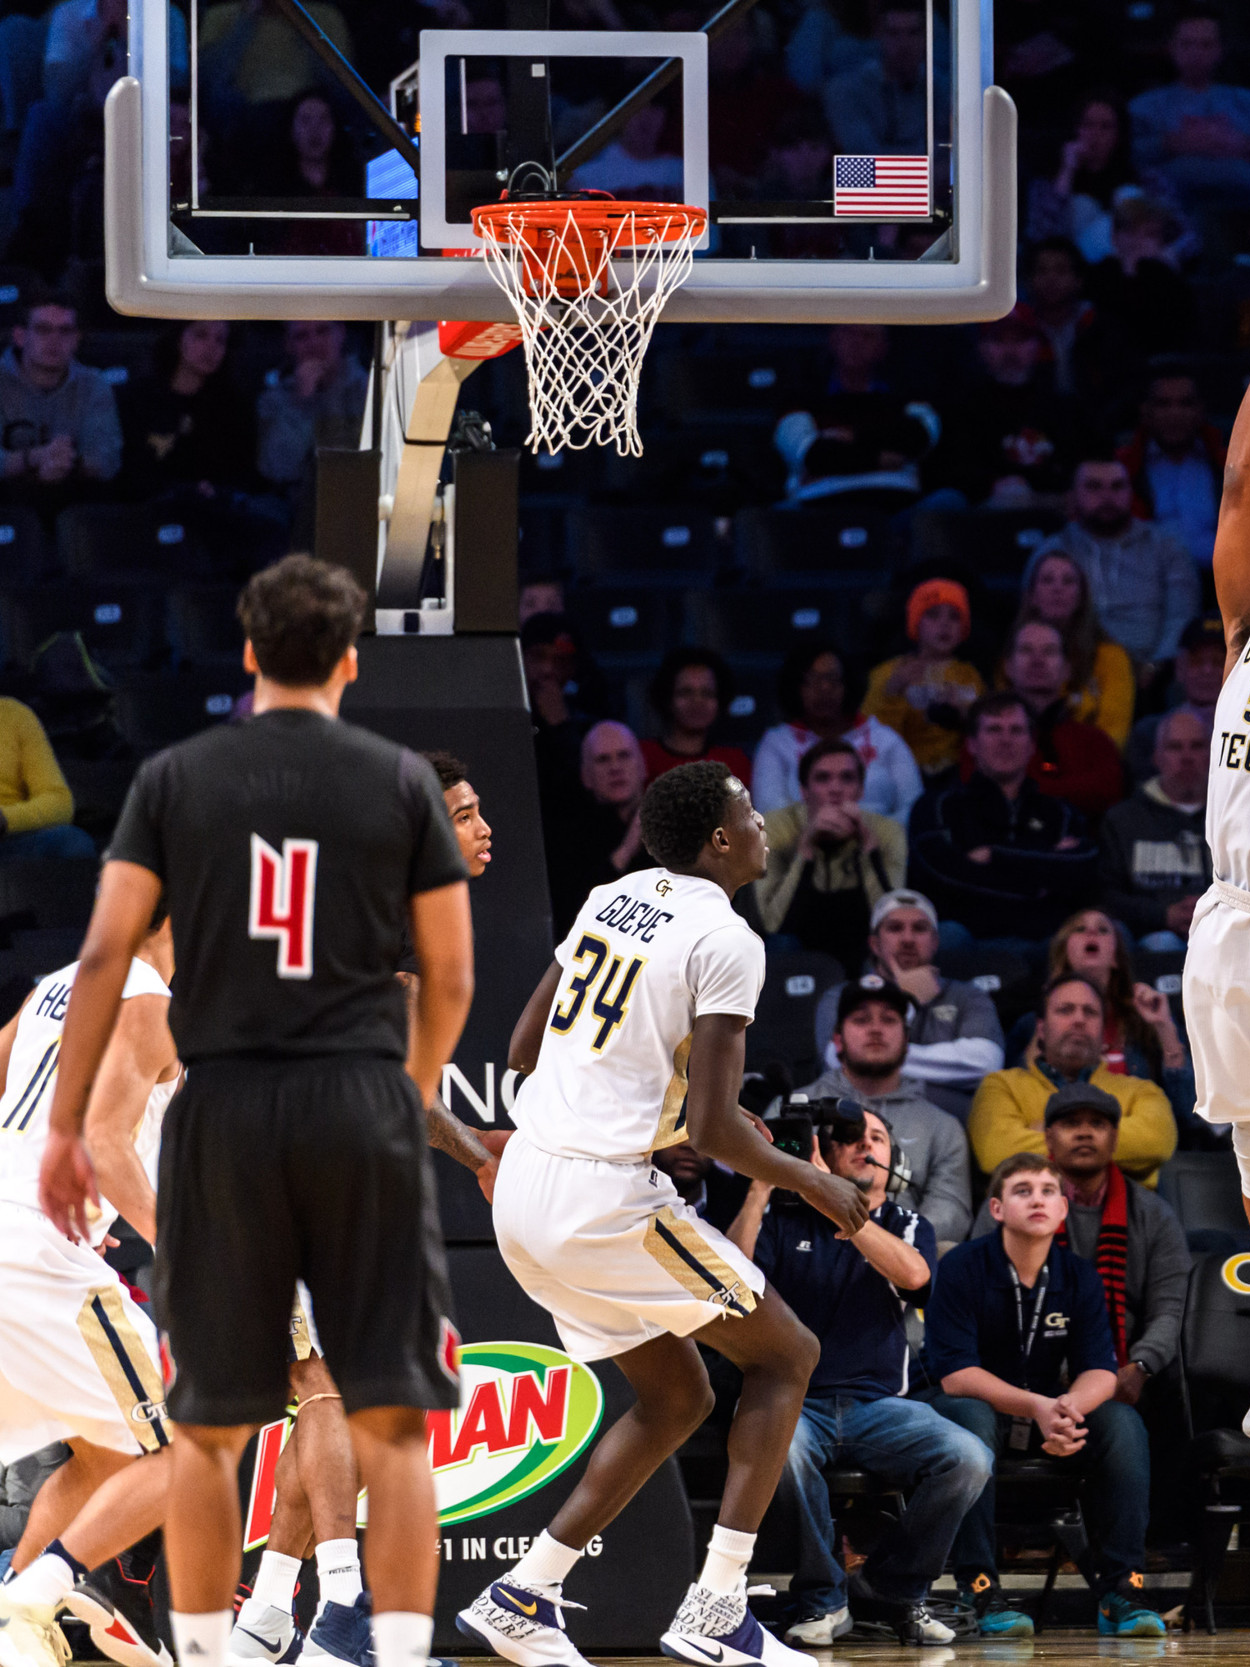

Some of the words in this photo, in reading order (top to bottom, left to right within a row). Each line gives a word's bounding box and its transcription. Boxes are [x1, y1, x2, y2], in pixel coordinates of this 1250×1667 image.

[655, 879, 673, 897] GT
[249, 832, 319, 981] 4
[595, 894, 674, 943] GUEYE
[550, 930, 649, 1055] 34
[1045, 1312, 1070, 1328] GT
[462, 1537, 486, 1561] IN
